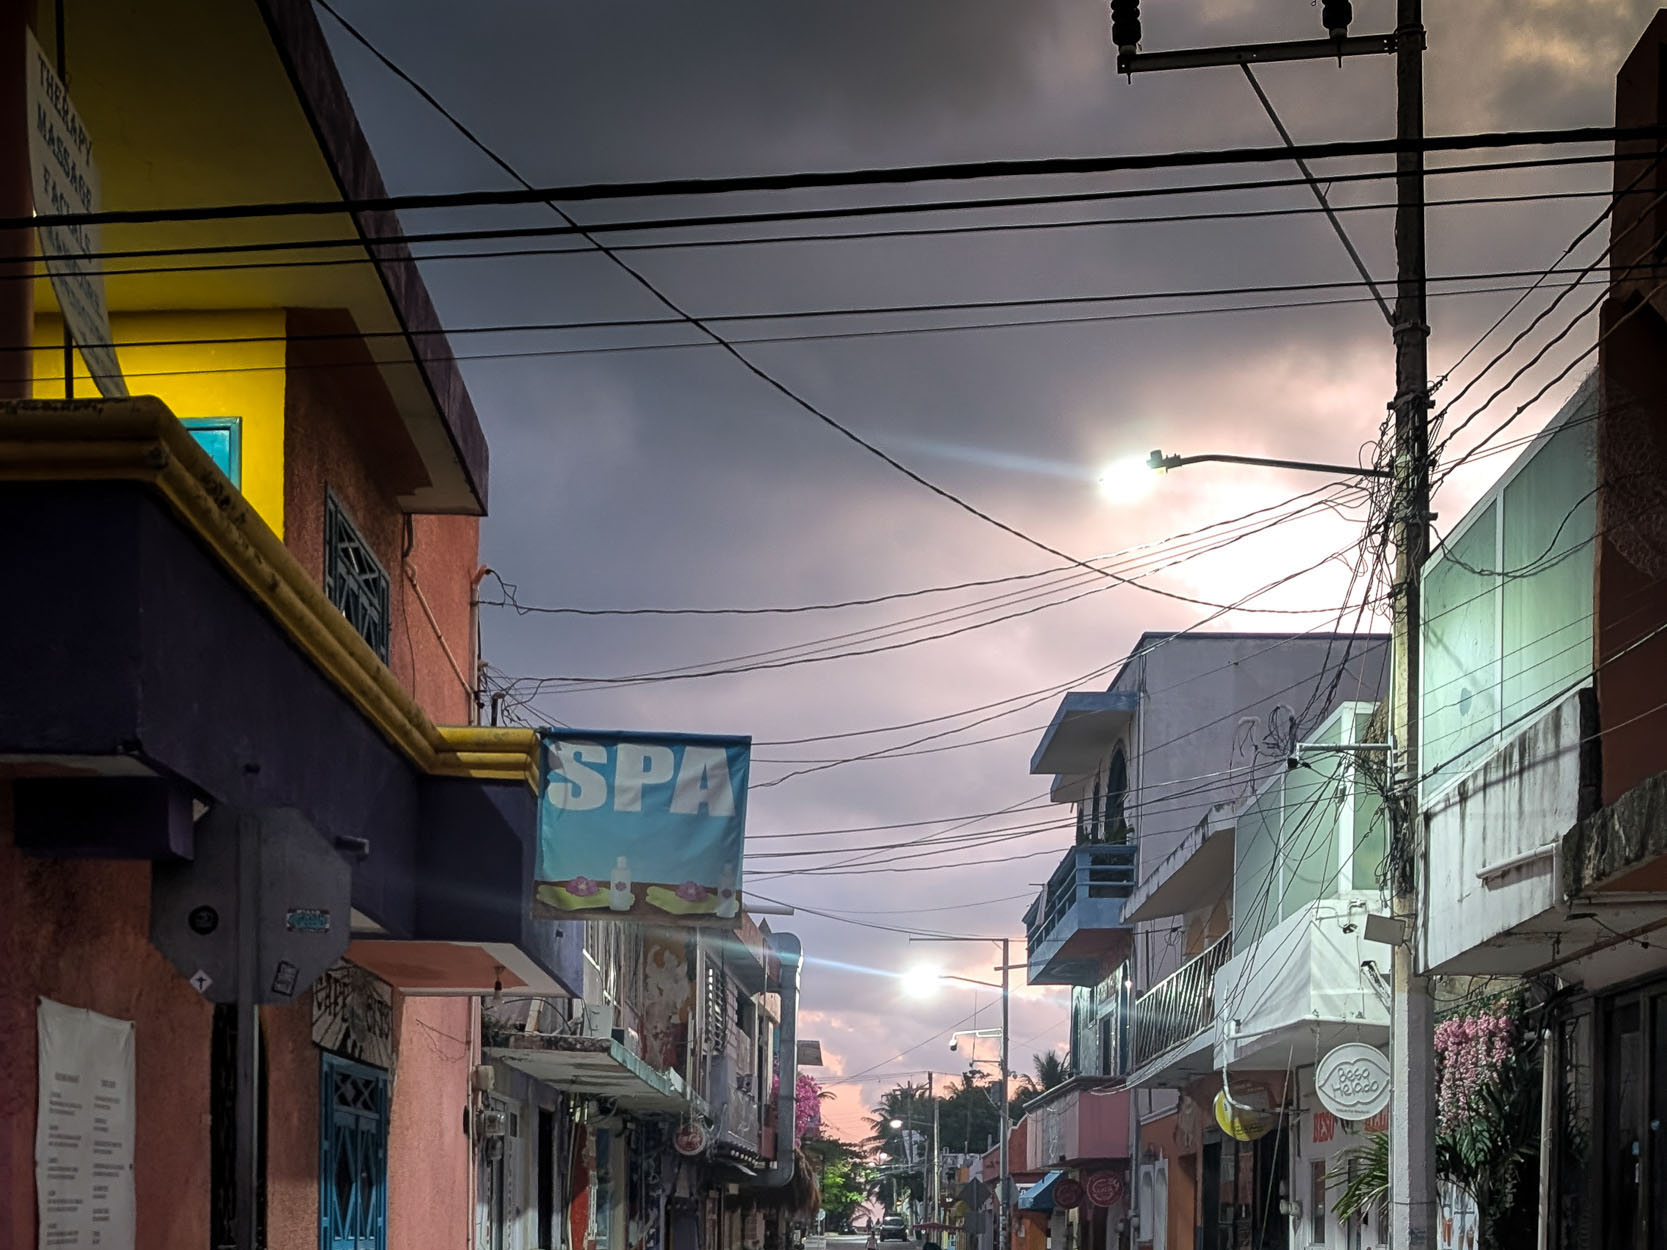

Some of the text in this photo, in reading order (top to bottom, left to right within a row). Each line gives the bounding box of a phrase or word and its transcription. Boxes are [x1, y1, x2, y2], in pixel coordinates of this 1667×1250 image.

[38, 54, 93, 165] THERAPY
[37, 104, 92, 213] MASSAGE
[548, 742, 736, 817] SPA
[1331, 1078, 1379, 1098] Helado
[1337, 1066, 1370, 1083] Beso
